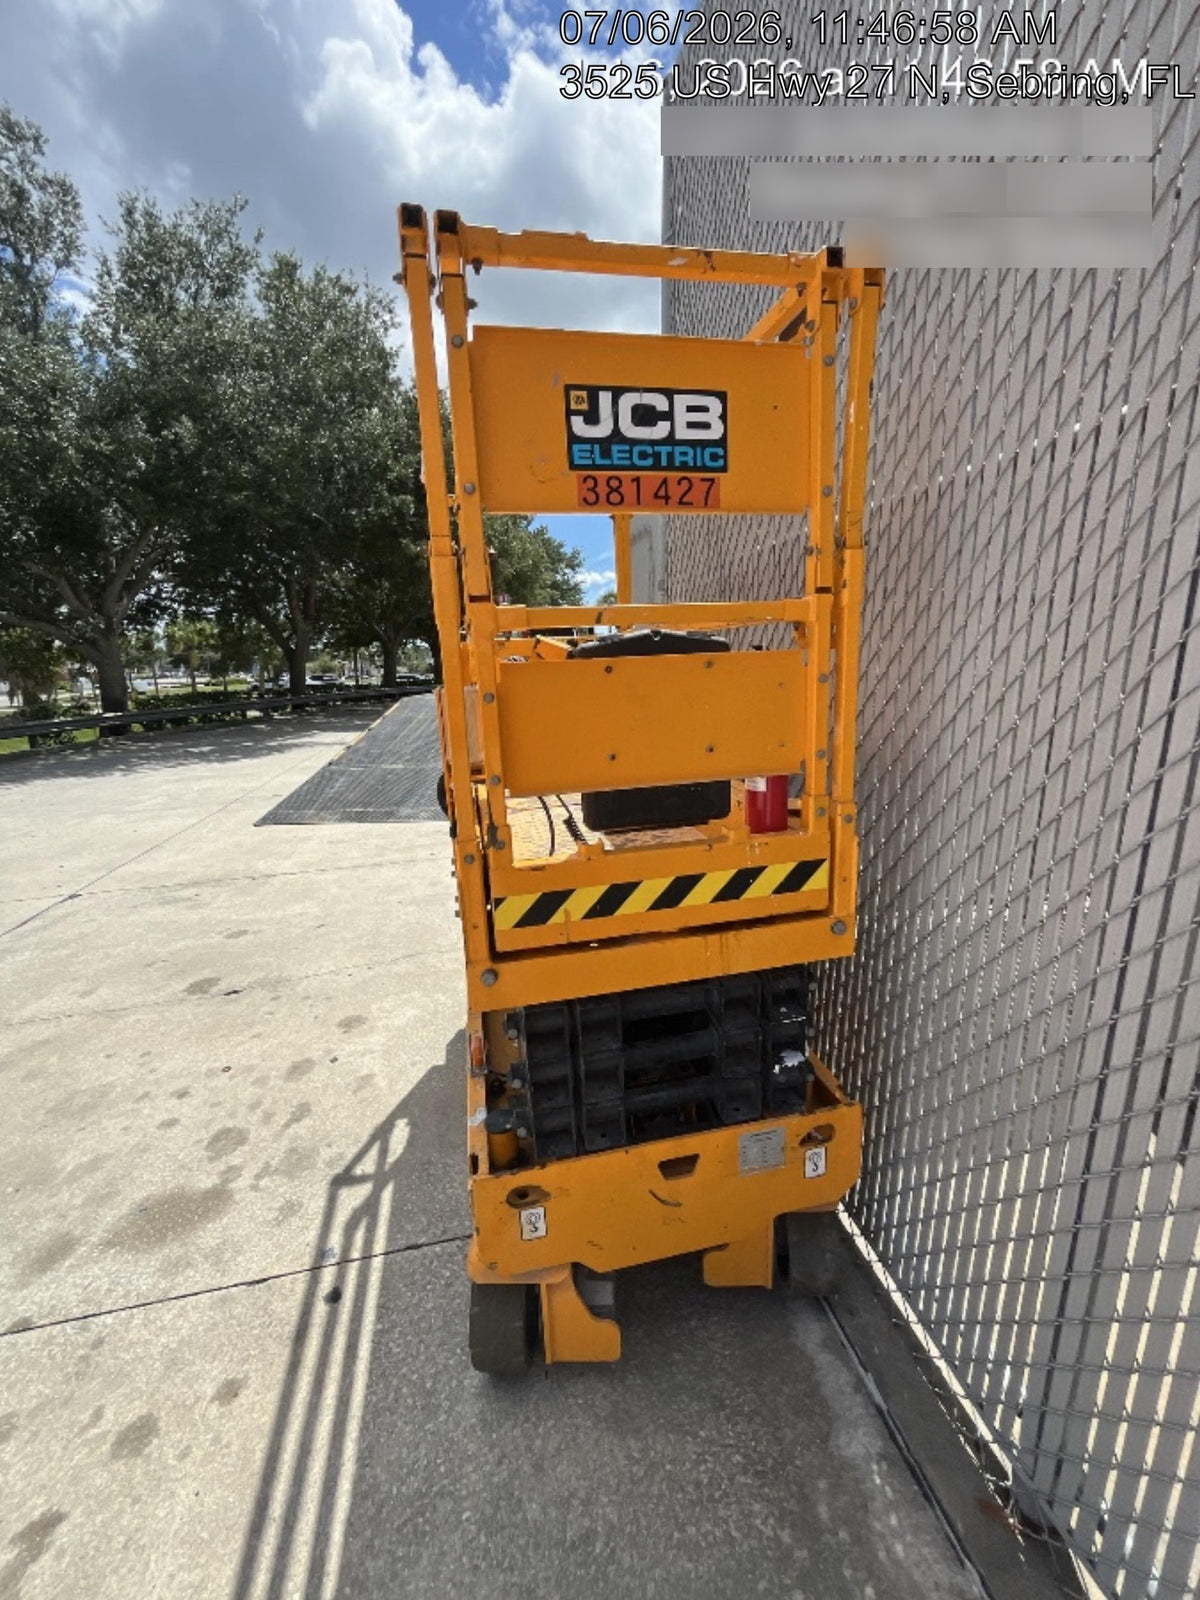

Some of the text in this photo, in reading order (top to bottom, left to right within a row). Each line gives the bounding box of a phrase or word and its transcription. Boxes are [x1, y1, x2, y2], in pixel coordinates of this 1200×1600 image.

[570, 390, 724, 440] JCB
[572, 444, 725, 467] ELECTRIC
[582, 475, 716, 507] 381427
